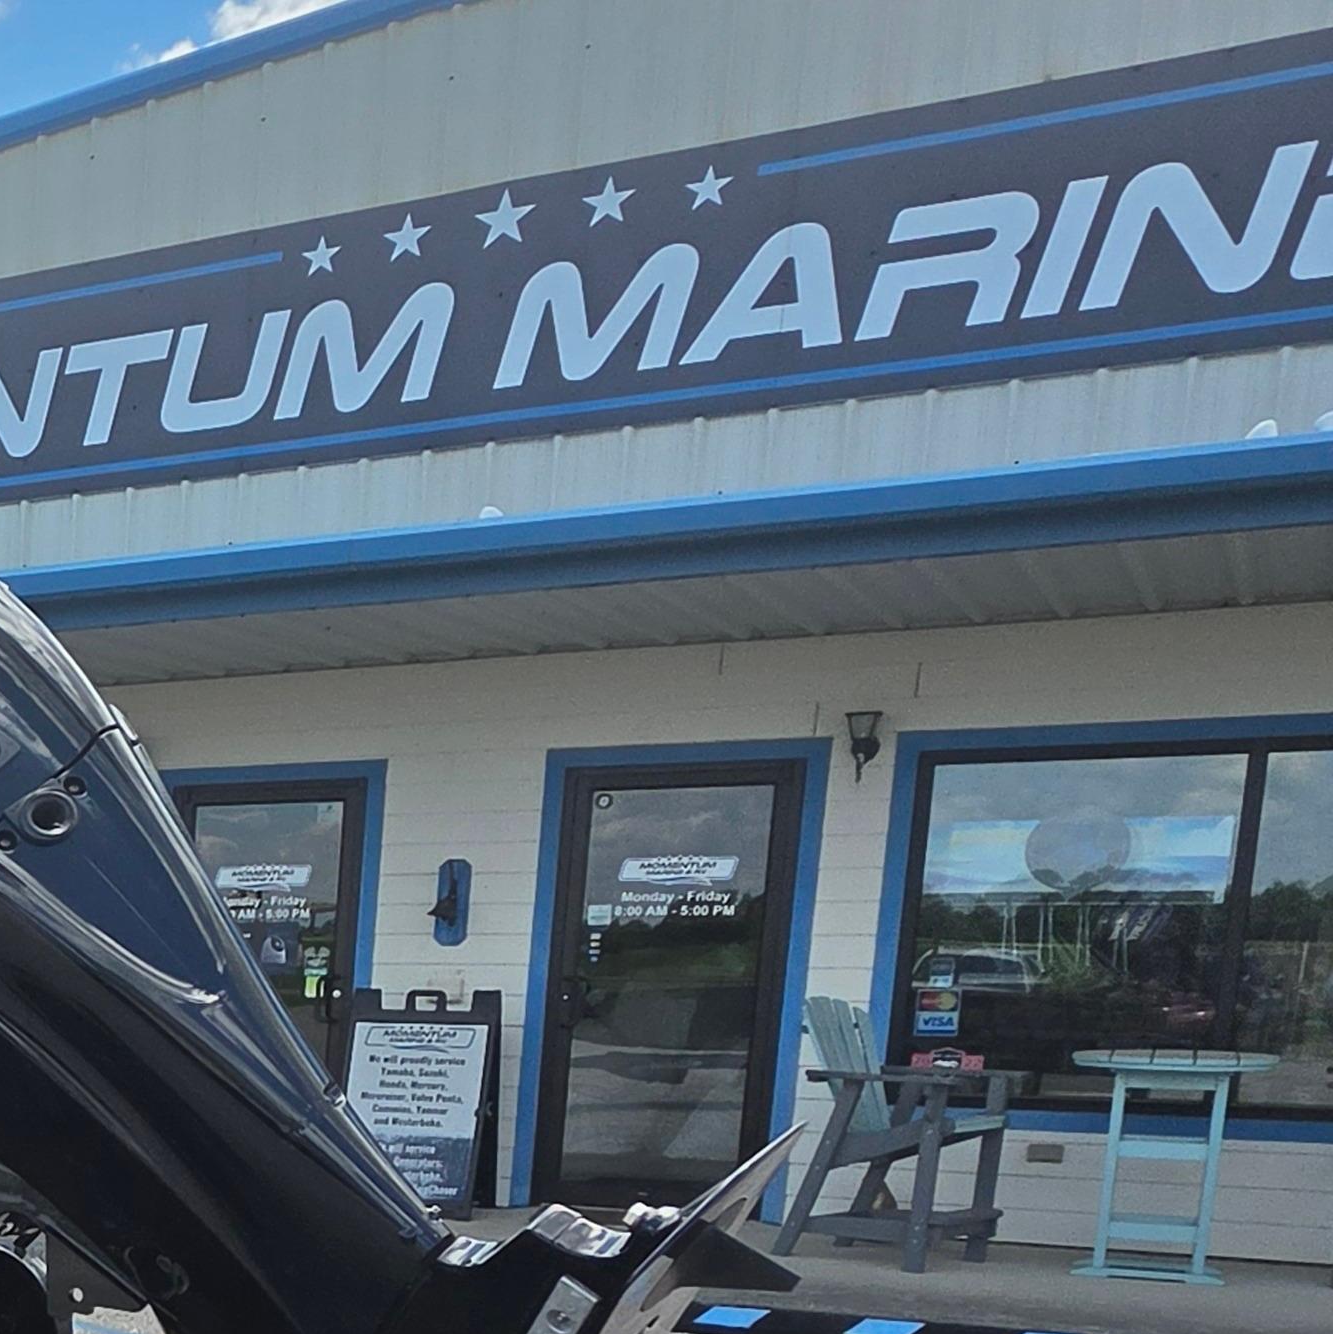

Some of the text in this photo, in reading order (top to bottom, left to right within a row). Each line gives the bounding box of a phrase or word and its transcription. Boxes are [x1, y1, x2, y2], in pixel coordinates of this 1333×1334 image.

[639, 862, 717, 870] MOMENTUM
[270, 895, 307, 908] Friday
[621, 891, 675, 904] Monday
[687, 890, 730, 904] Friday
[238, 909, 256, 919] AM
[266, 908, 290, 919] 5:00
[292, 908, 311, 919] PM
[614, 905, 642, 916] 8:00
[645, 905, 668, 916] AM
[680, 904, 709, 916] 5:00
[712, 904, 735, 916] PM
[922, 1016, 954, 1027] VISA
[369, 1055, 466, 1066] We will proudly service
[381, 1067, 450, 1078] Yamaha, Suzuki,
[373, 1116, 389, 1125] and
